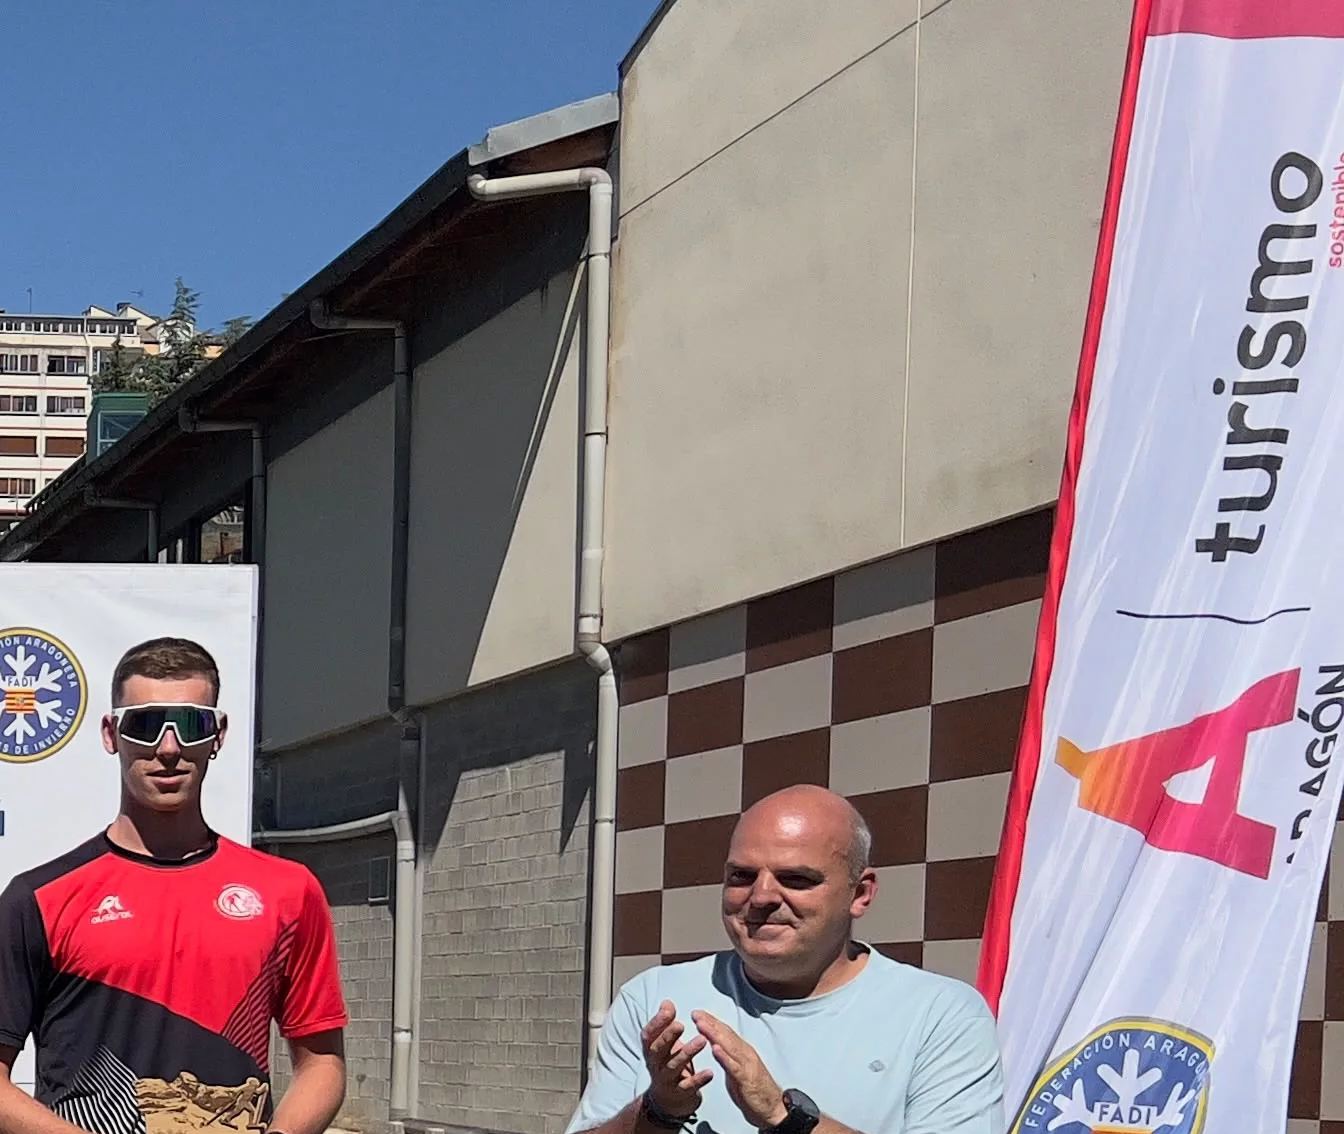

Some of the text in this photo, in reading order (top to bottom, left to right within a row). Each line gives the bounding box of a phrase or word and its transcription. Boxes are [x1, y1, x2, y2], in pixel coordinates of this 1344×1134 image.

[1195, 150, 1324, 564] turismo
[7, 677, 33, 687] FADI
[14, 745, 29, 755] DE
[1025, 1031, 1131, 1128] FEDERACIÓN
[1098, 1104, 1152, 1125] FADI
